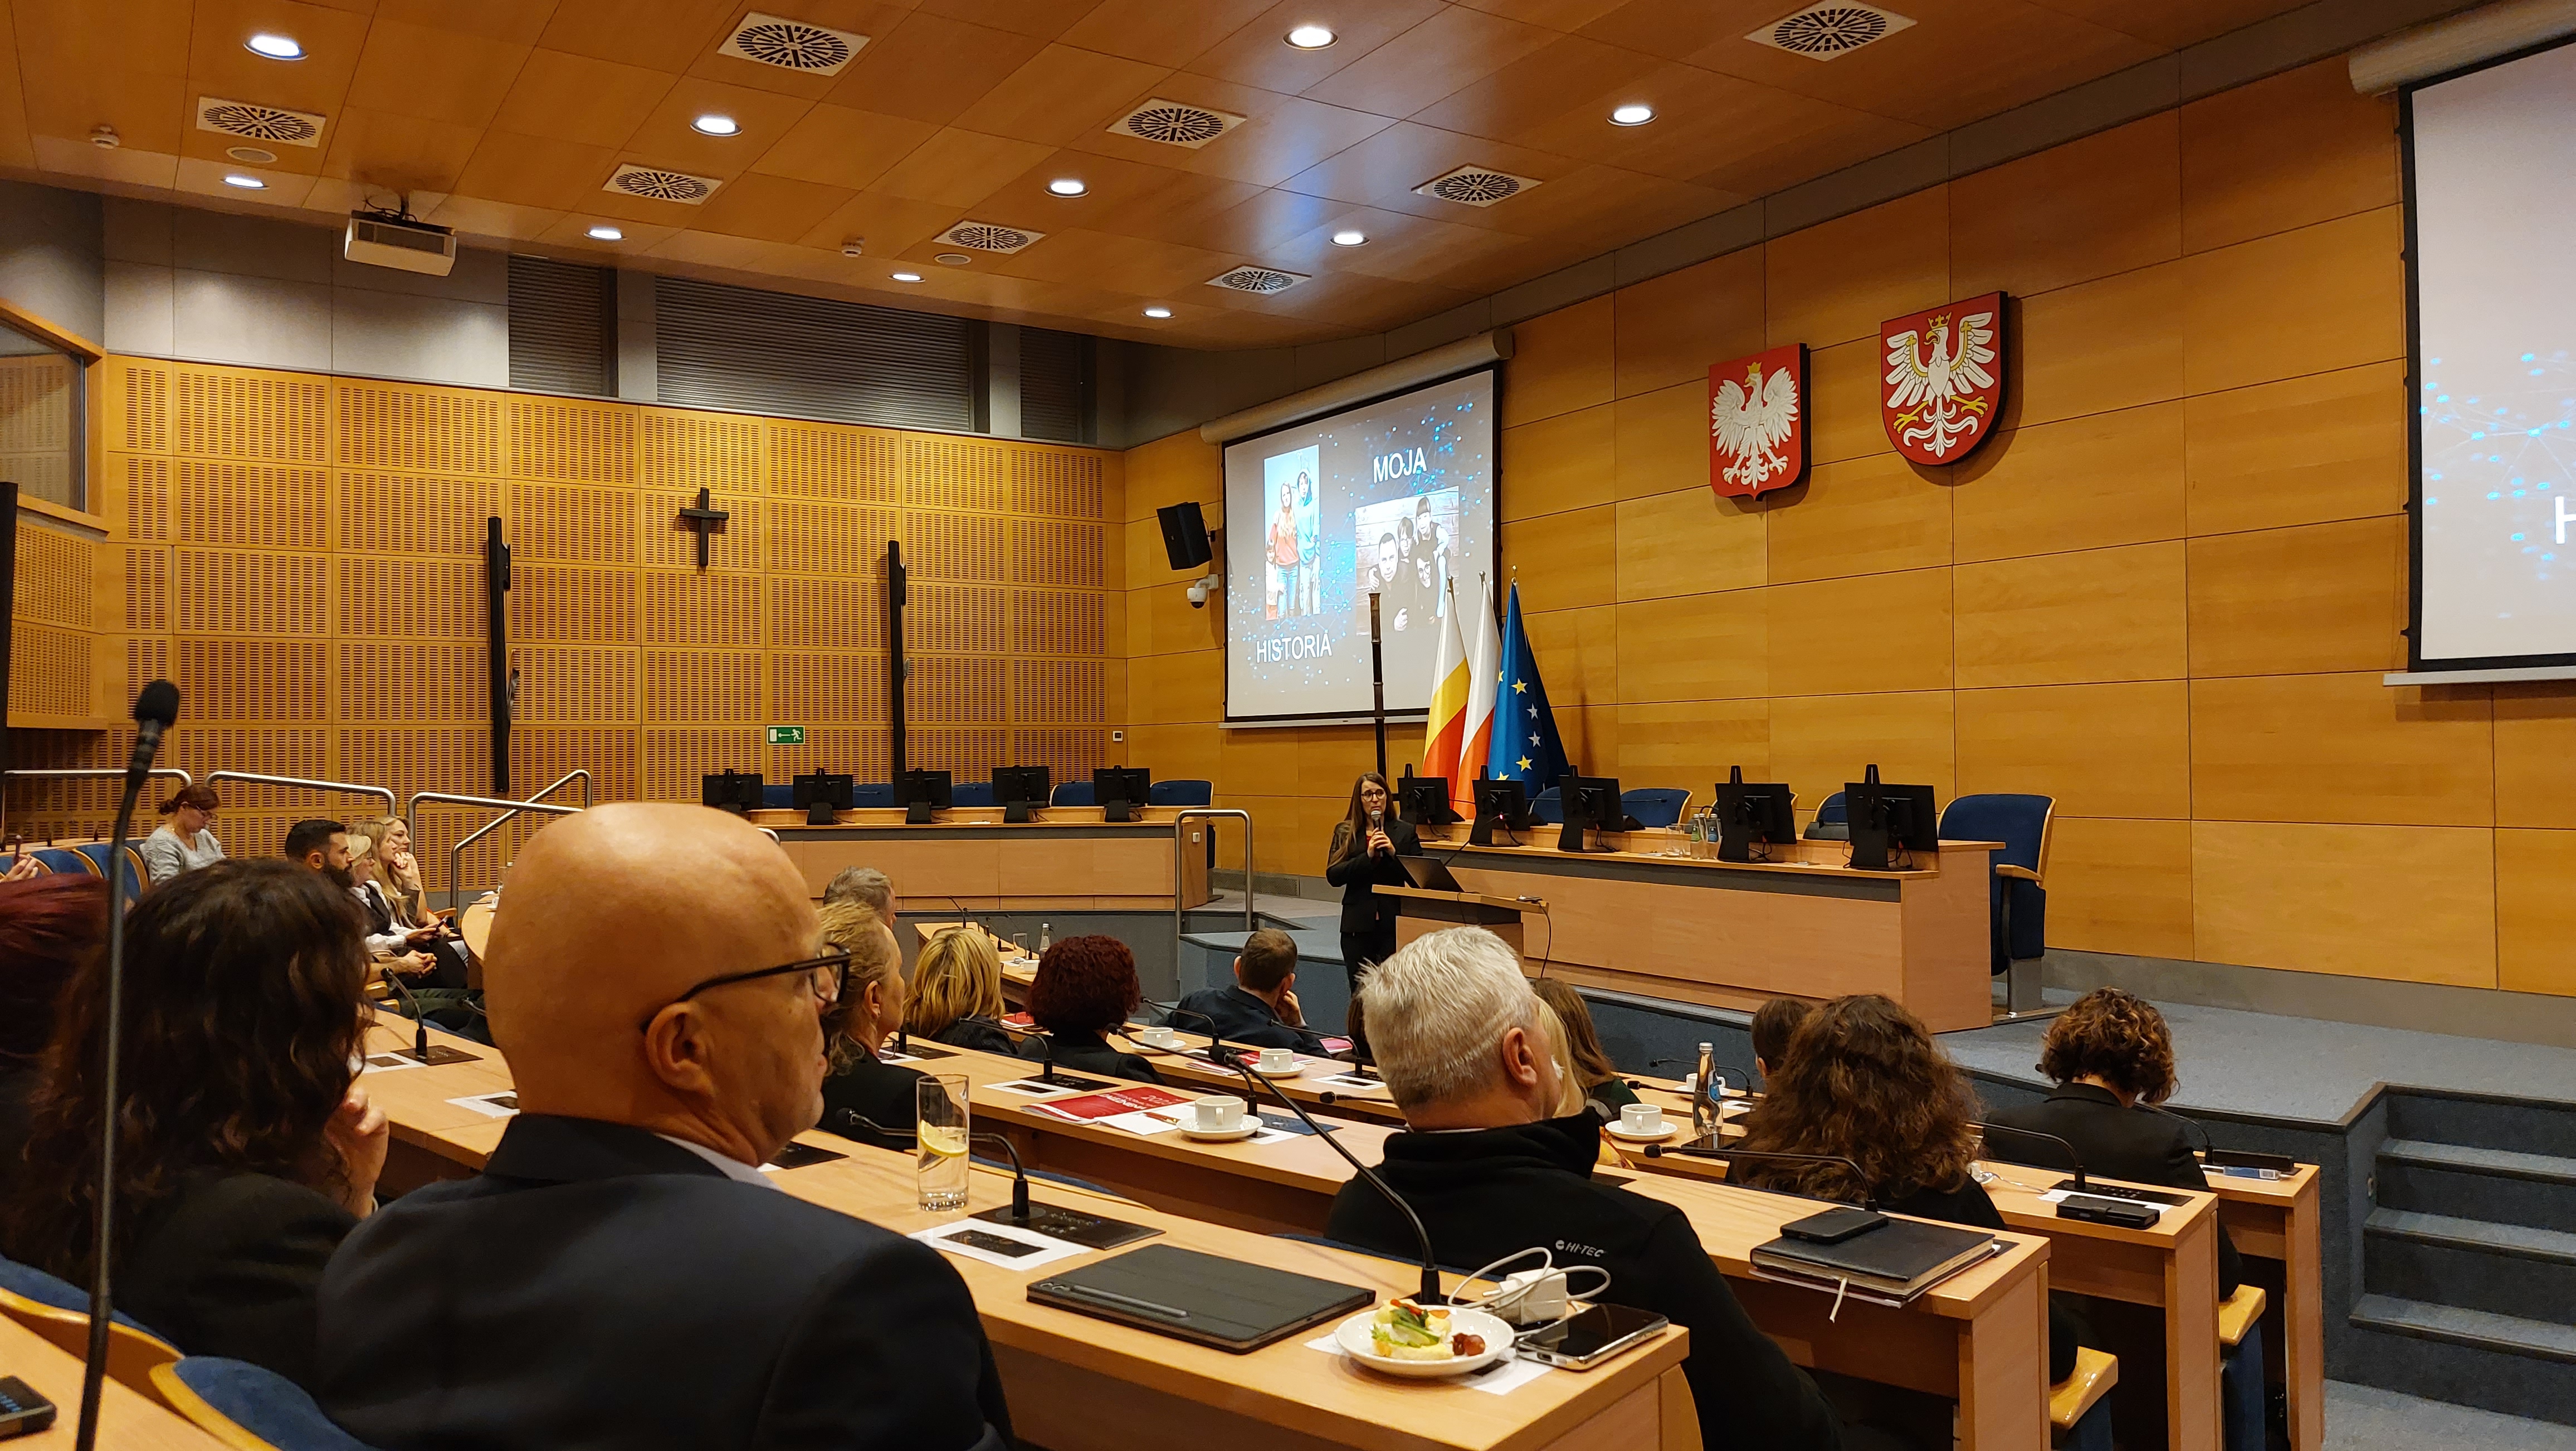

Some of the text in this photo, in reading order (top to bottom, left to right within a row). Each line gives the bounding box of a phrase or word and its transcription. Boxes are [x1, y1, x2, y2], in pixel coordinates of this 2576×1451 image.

[1373, 447, 1427, 484] MOJA
[1256, 633, 1332, 663] HISTORIA
[1565, 1241, 1604, 1258] HI-TEC
